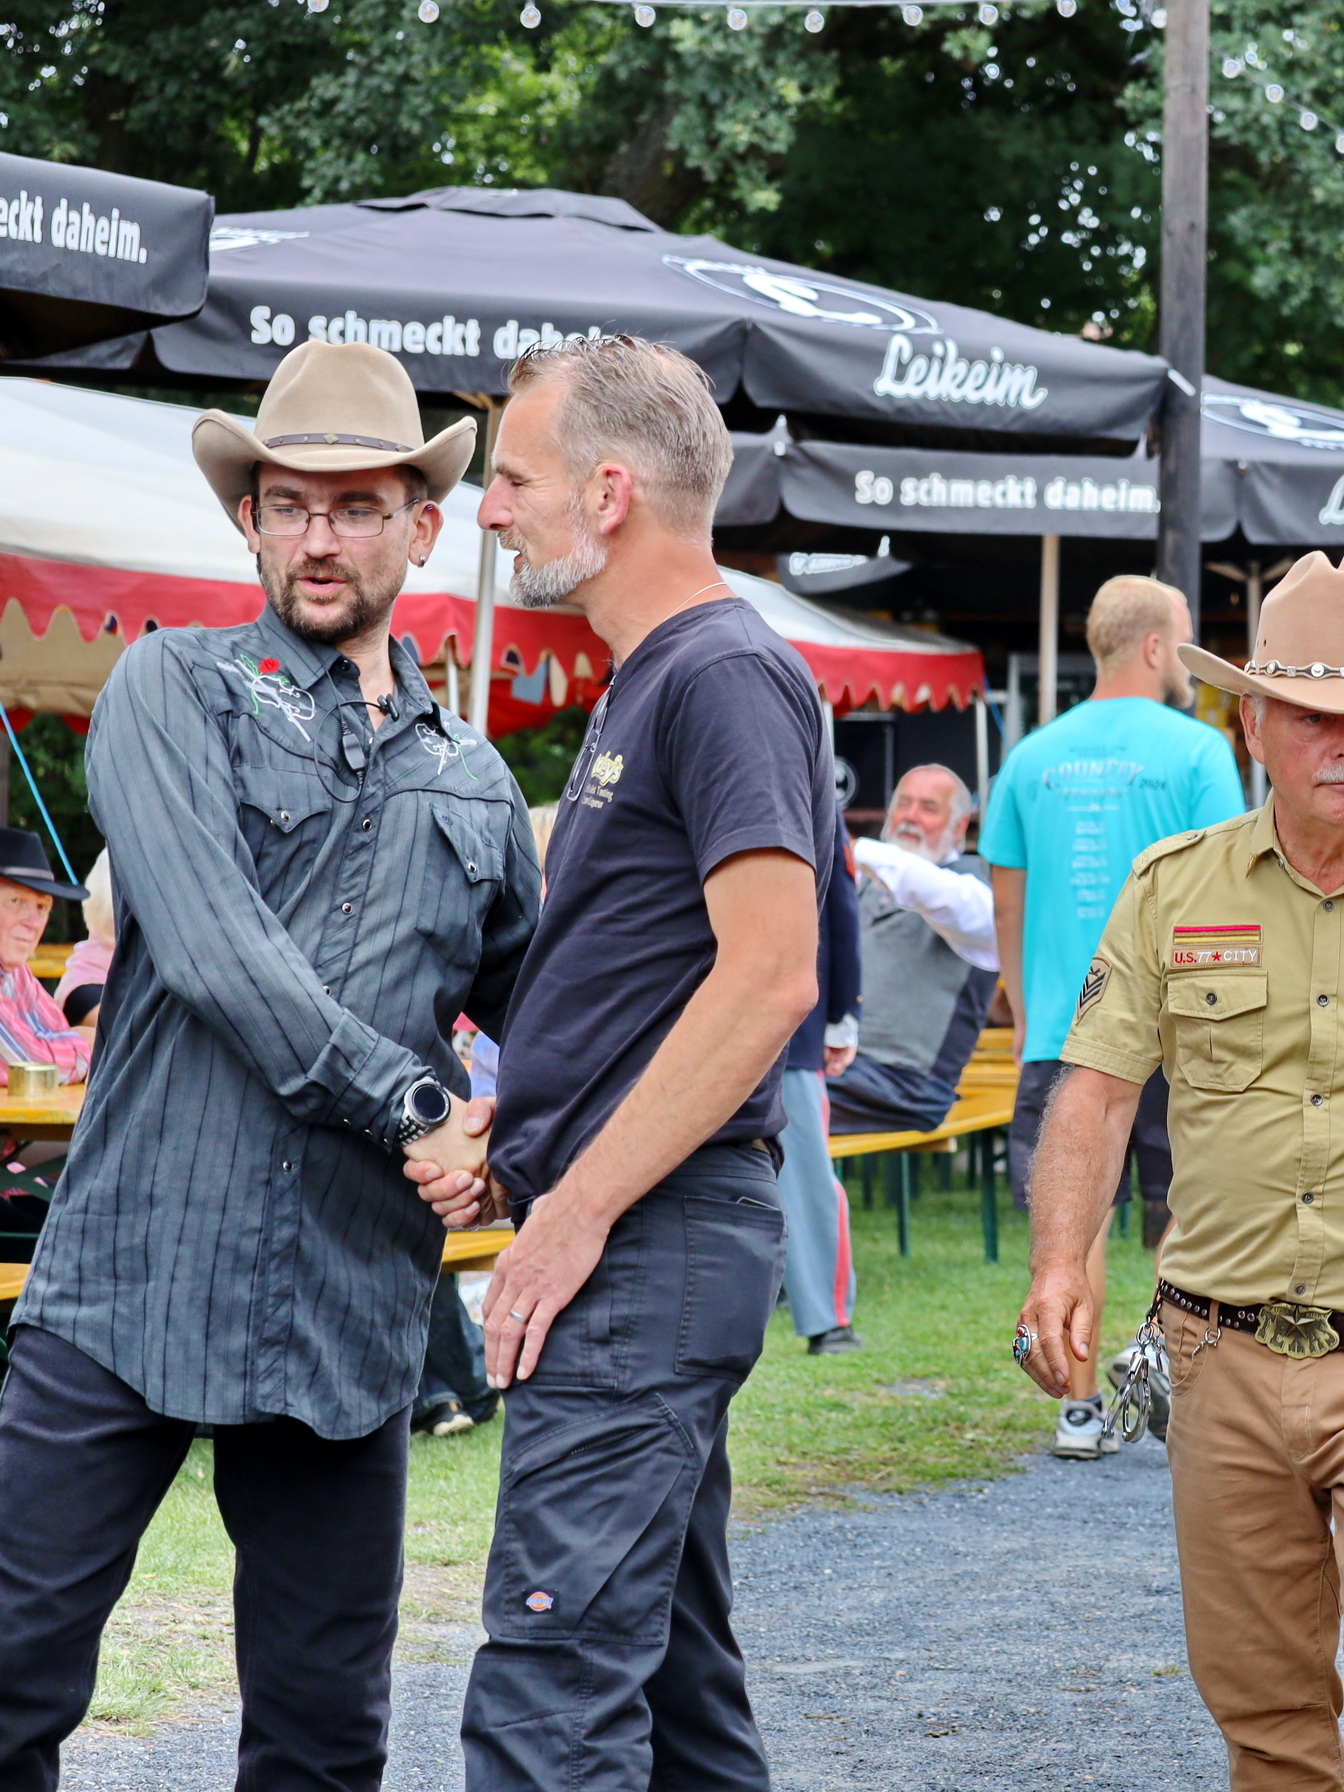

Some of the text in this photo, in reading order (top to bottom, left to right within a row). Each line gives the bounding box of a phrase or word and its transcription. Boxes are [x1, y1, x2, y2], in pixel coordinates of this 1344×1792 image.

[51, 197, 148, 264] daheim.
[249, 305, 296, 346] So
[307, 310, 481, 357] schmeckt
[873, 334, 1048, 409] Leikeim
[855, 469, 894, 505] So
[900, 473, 1037, 509] schmeckt
[1223, 949, 1257, 962] CITY
